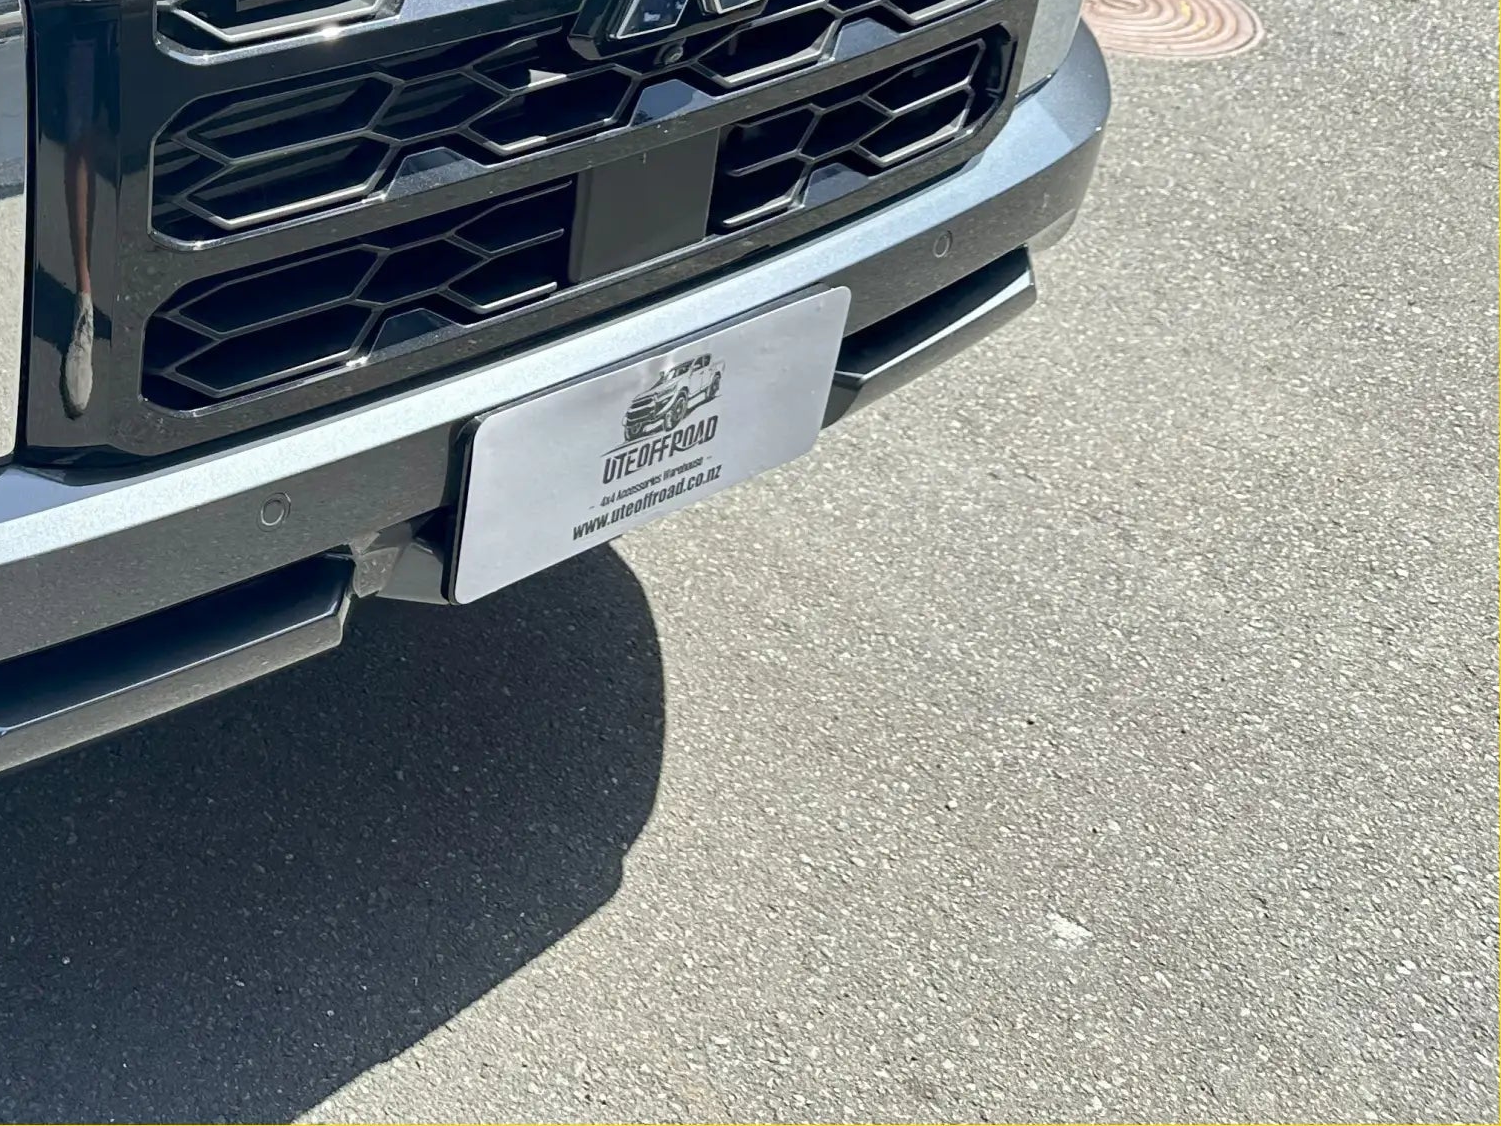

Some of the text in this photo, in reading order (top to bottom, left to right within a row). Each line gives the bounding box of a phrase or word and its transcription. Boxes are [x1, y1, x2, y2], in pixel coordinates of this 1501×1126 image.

[600, 456, 704, 507] 4x4 Accessories Warehouse
[602, 415, 719, 485] UTEOFFROAD
[573, 464, 723, 541] www.uteoffroad.co.nz
